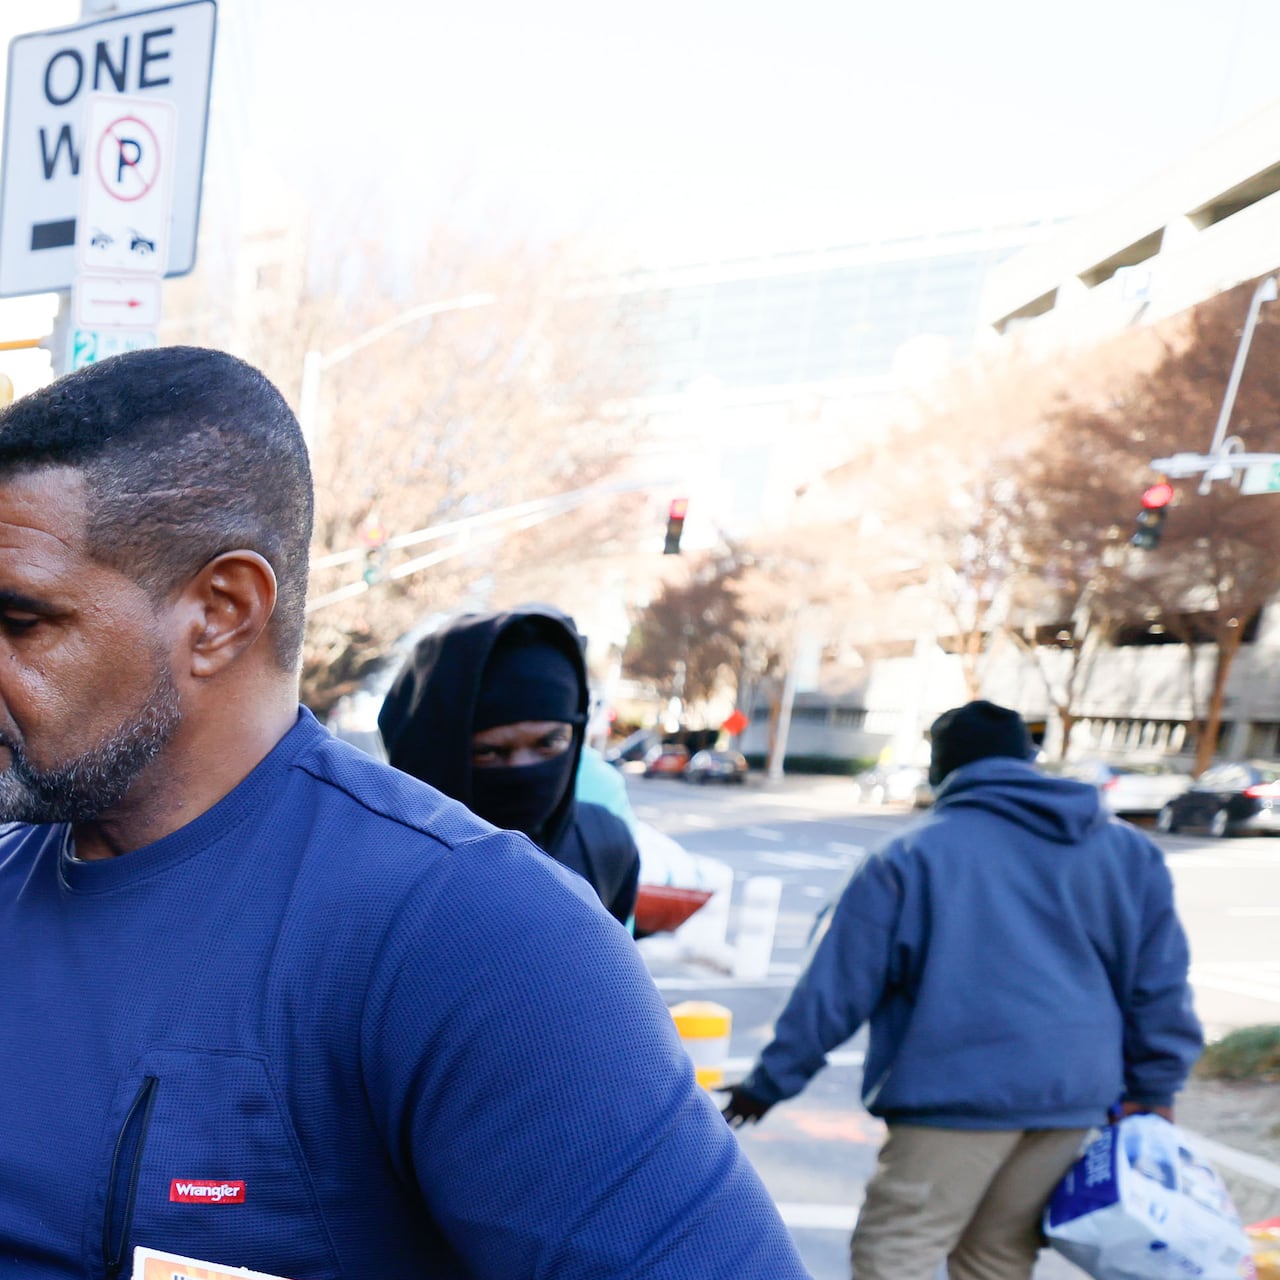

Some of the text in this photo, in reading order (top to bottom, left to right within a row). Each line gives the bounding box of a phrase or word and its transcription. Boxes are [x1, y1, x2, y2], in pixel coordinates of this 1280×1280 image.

[44, 27, 175, 106] ONE
[38, 123, 80, 181] W
[175, 1183, 240, 1201] Wrangler
